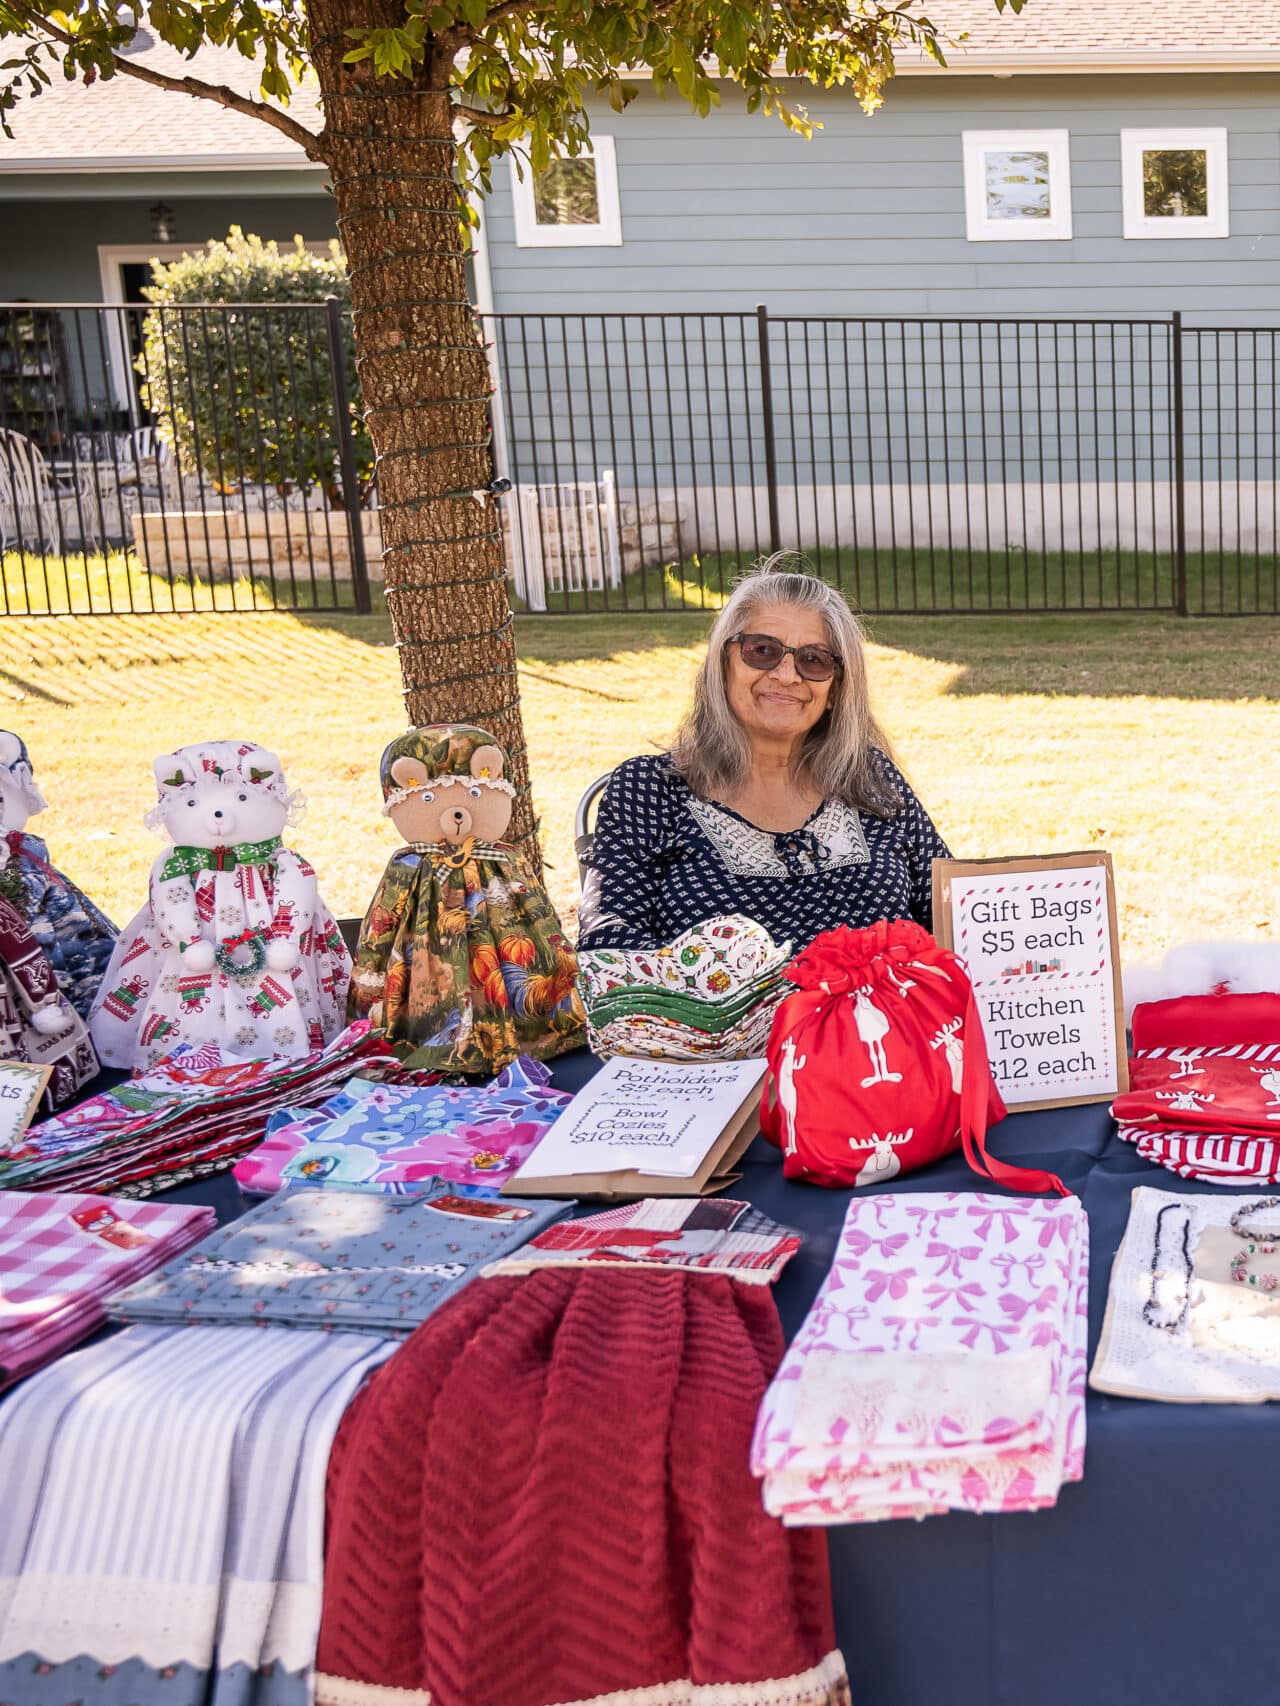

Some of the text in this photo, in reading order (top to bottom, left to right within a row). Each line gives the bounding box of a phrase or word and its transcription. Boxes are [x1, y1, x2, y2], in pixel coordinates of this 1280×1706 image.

[970, 897, 1092, 923] Gift Bags
[982, 925, 1085, 956] $5 each
[987, 996, 1085, 1022] Kitchen
[994, 1024, 1081, 1050] Towels
[1037, 1051, 1097, 1076] each
[611, 1069, 740, 1085] Potholders
[616, 1083, 714, 1095] $5 each
[613, 1108, 669, 1119] Bowl
[596, 1119, 668, 1130] Cozies
[574, 1130, 672, 1144] $10 each
